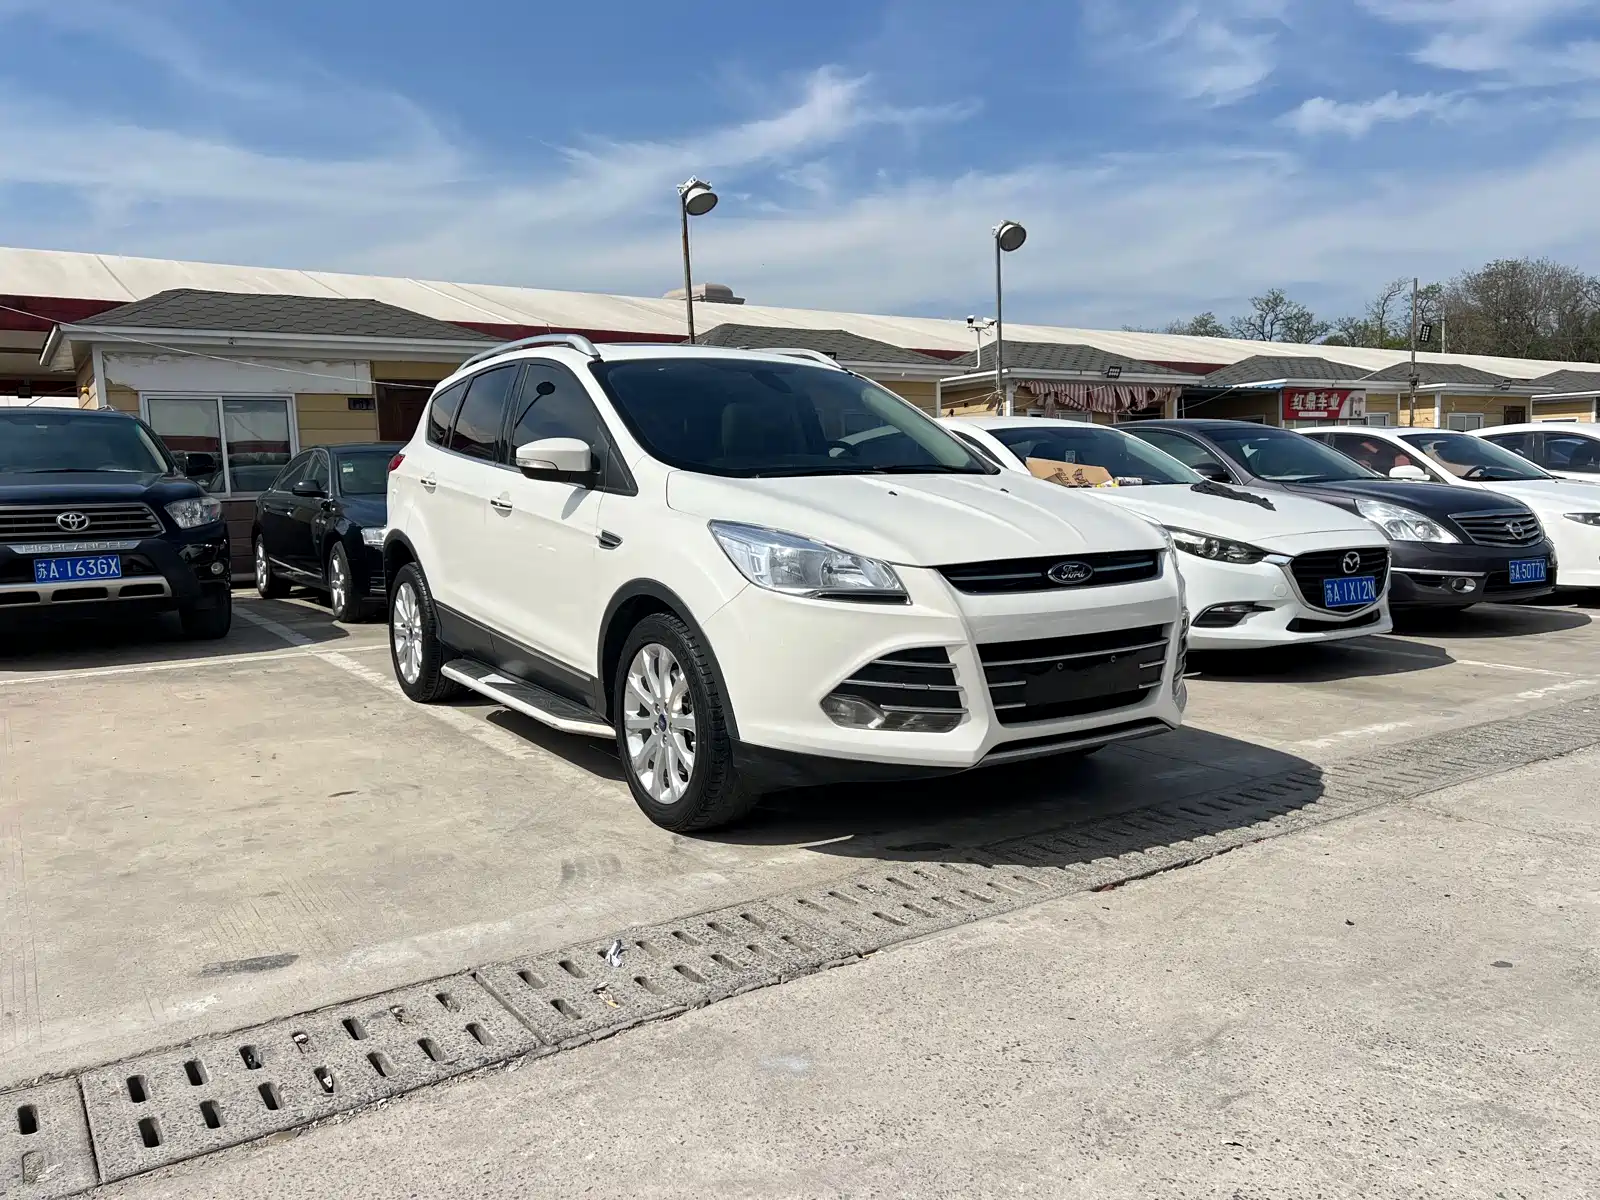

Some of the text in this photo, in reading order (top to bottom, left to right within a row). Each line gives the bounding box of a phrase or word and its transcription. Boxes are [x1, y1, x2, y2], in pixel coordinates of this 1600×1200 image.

[1290, 391, 1340, 411] 红鼎车业
[1060, 564, 1086, 580] Ford
